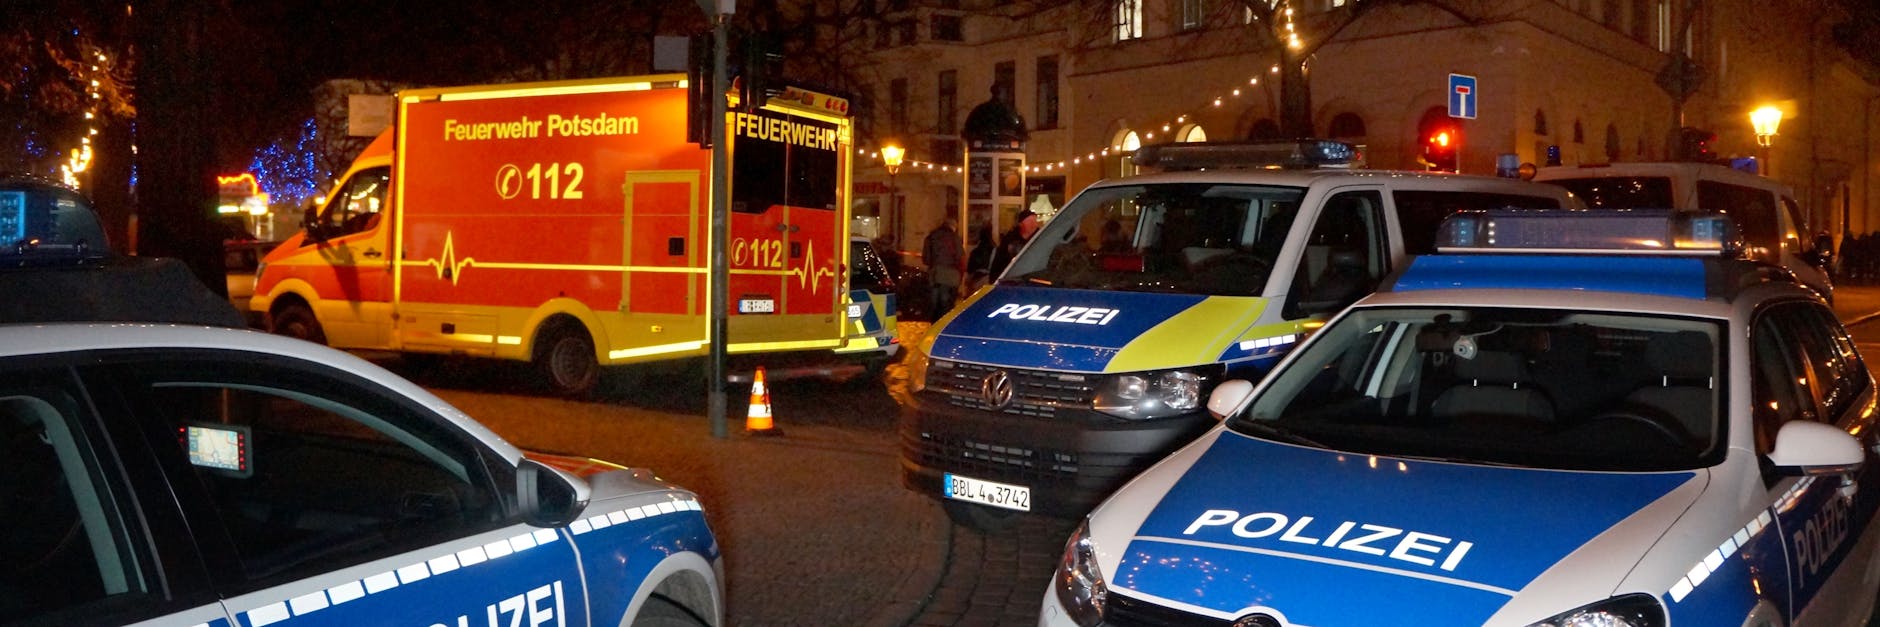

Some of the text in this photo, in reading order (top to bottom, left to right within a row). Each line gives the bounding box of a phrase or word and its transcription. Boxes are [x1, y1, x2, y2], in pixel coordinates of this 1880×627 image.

[445, 113, 639, 141] Feuerwehr Potsdam
[736, 112, 837, 151] FEUERWEHR
[526, 162, 584, 199] 112
[750, 238, 783, 268] 112
[988, 303, 1120, 325] POLIZEI
[952, 478, 1028, 508] BBL 4 3742
[1182, 509, 1474, 572] POLIZEI
